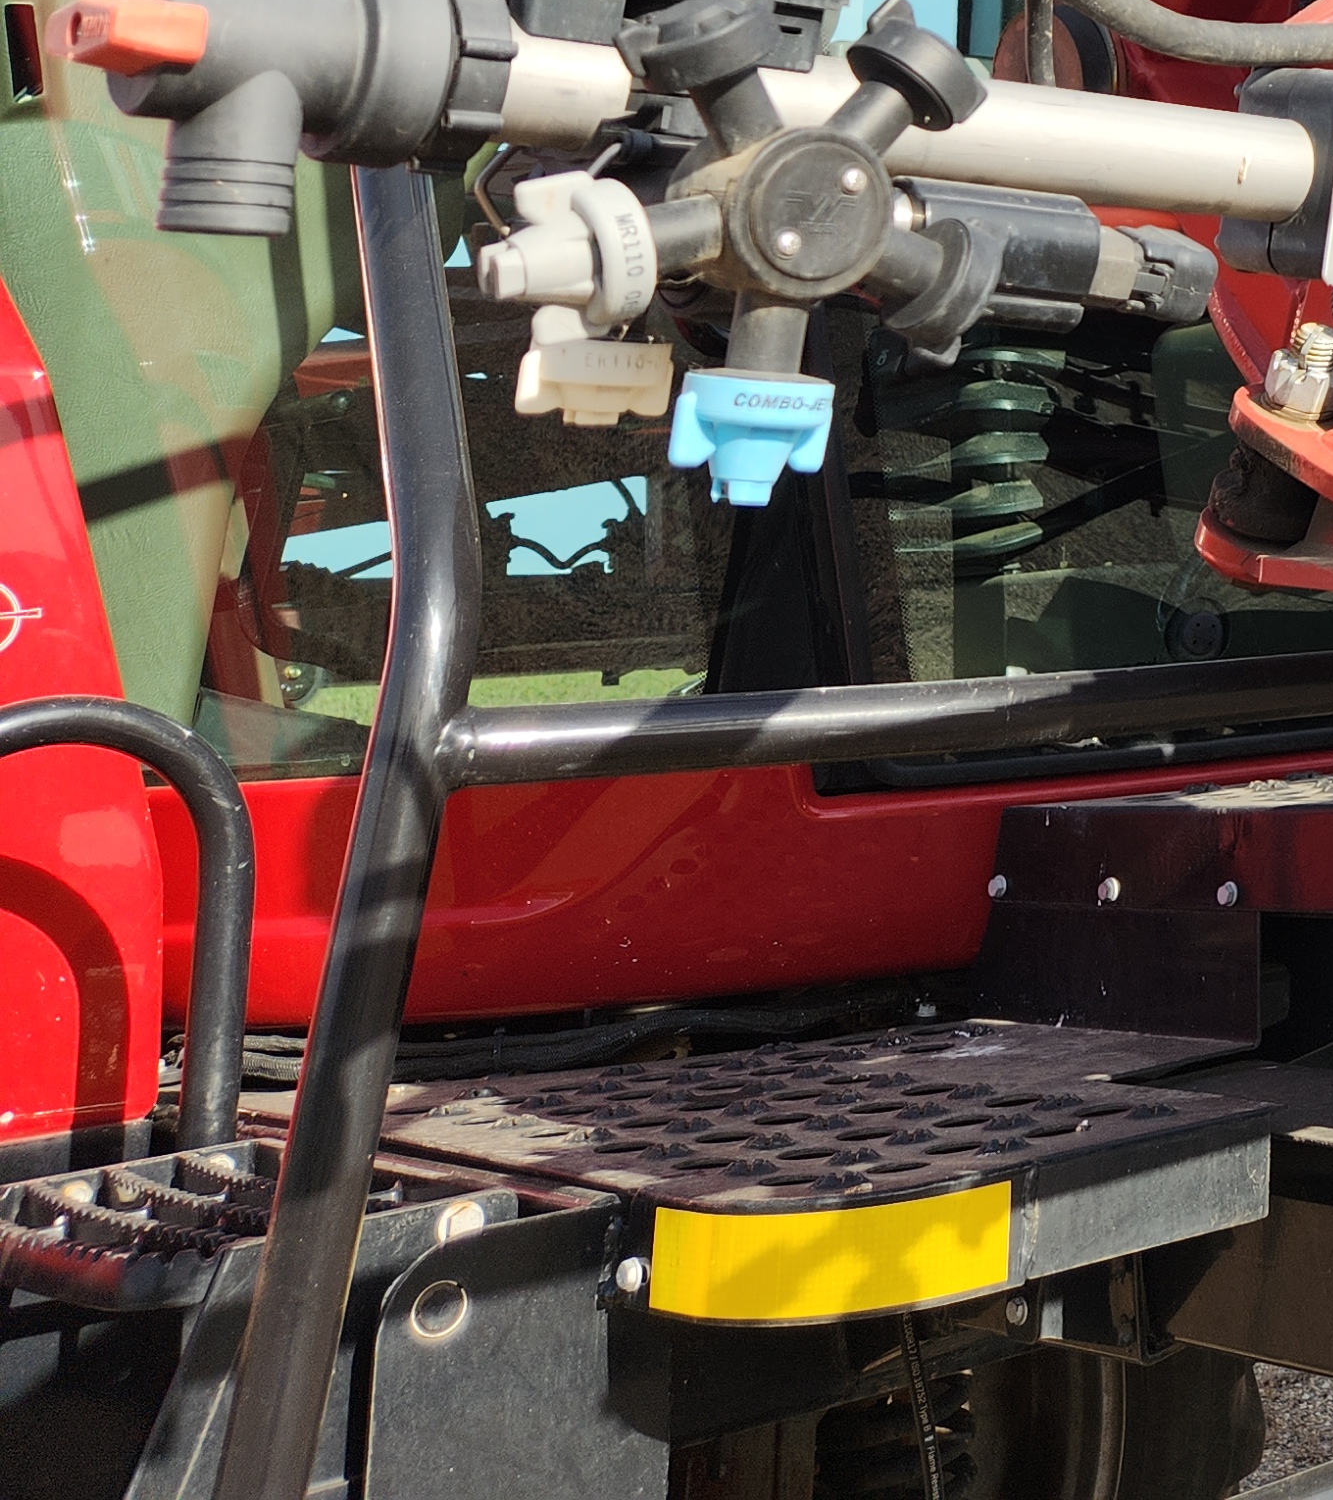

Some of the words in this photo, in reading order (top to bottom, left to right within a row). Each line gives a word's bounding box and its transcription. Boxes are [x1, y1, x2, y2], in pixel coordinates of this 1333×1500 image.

[614, 213, 644, 278] MR110
[902, 1323, 918, 1355] 100R17
[912, 1376, 927, 1405] 18752
[916, 1404, 931, 1426] Type
[924, 1445, 939, 1473] Flame
